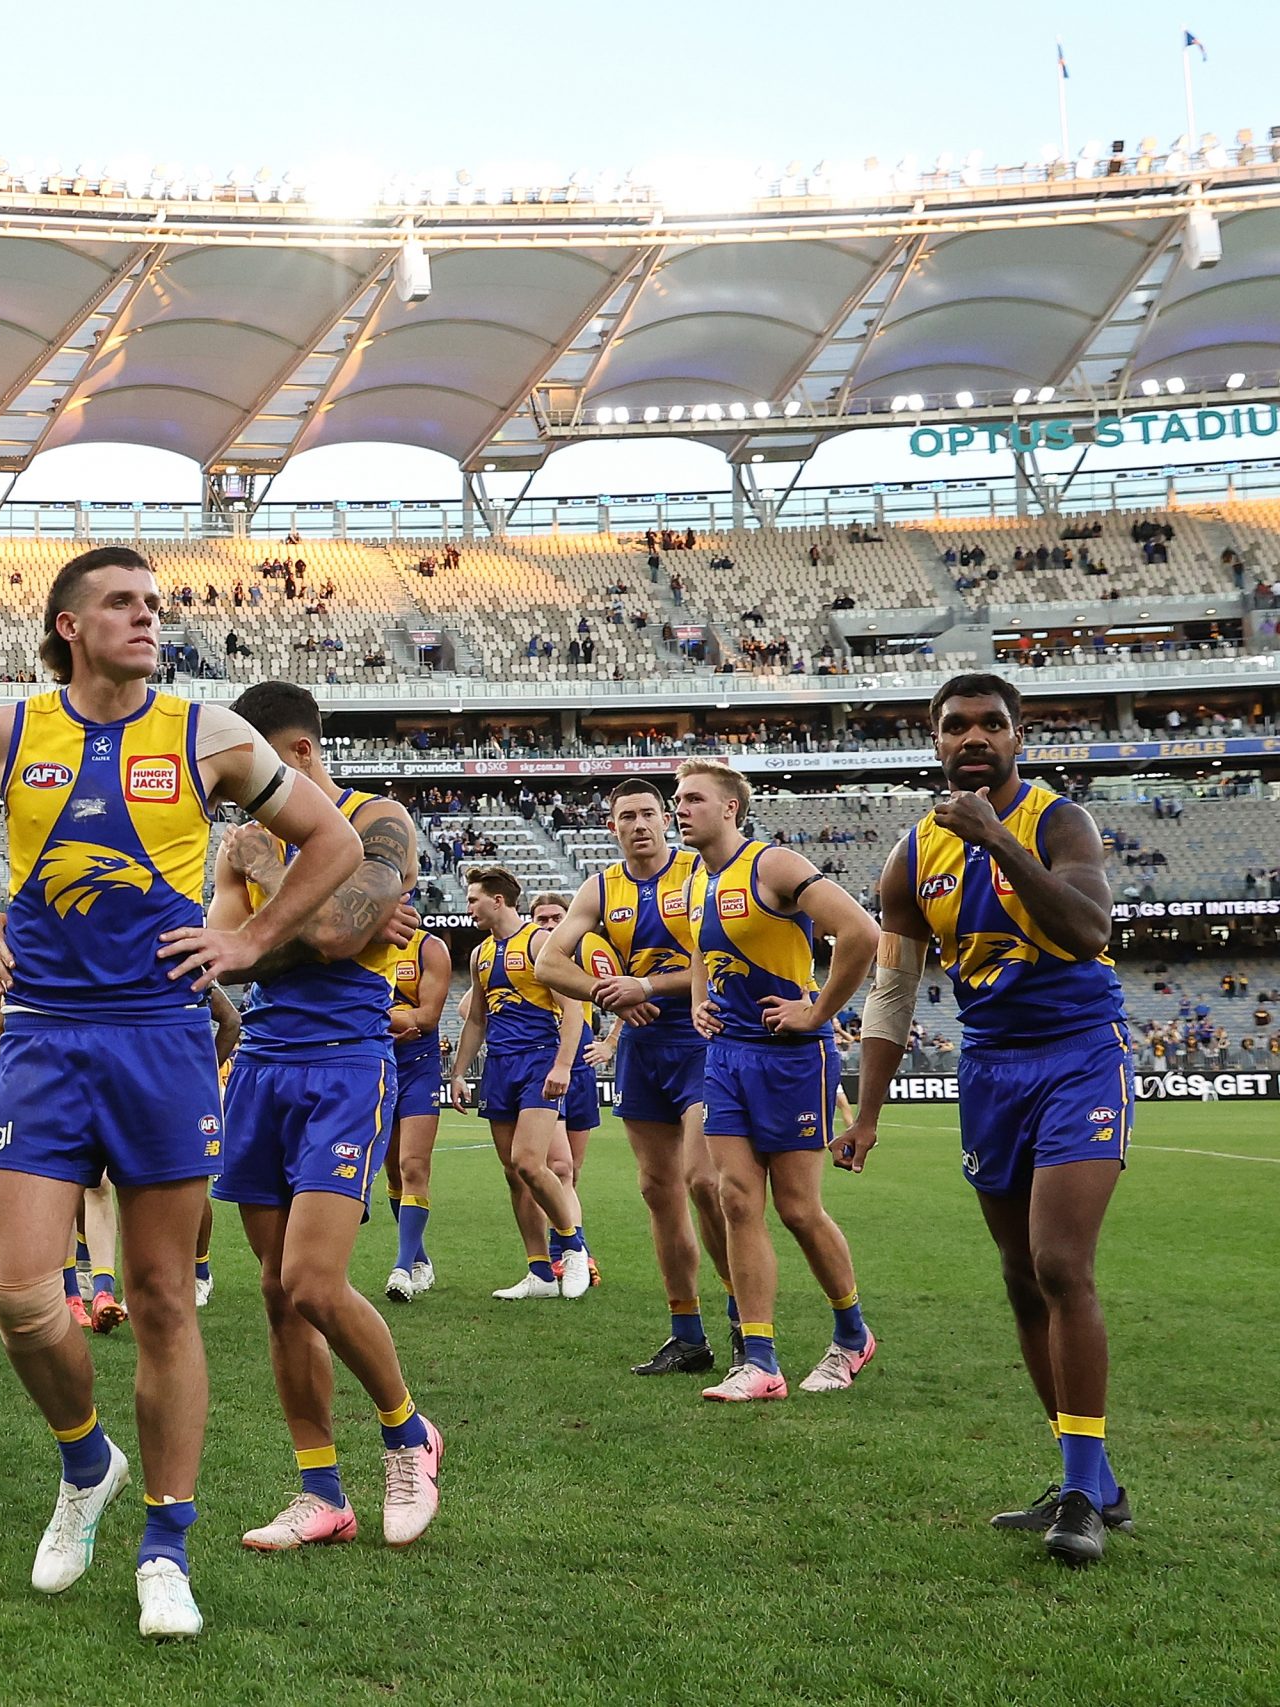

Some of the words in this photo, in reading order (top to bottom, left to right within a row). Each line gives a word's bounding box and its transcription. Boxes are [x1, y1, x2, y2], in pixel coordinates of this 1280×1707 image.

[909, 420, 1076, 457] OPTUS
[1095, 407, 1280, 447] STADIU
[1026, 748, 1090, 760] EAGLES
[1160, 742, 1226, 755] EAGLES
[487, 762, 508, 771] SKG
[591, 761, 612, 770] SKG
[624, 761, 671, 770] skg.com.au
[832, 757, 903, 765] WORLD-CLASS
[340, 763, 401, 775] grounded.
[404, 762, 463, 774] grounded.
[519, 763, 566, 772] skg.com.au
[26, 768, 69, 783] AFL
[133, 770, 174, 778] HUNGRY
[132, 778, 174, 790] JACK'S
[922, 878, 954, 897] AFL
[611, 909, 631, 920] AFL
[1111, 901, 1166, 917] HINGS
[1168, 902, 1204, 916] GET
[423, 915, 476, 928] CROW
[1135, 1072, 1207, 1099] INGS
[1213, 1074, 1272, 1096] GET
[798, 1112, 817, 1122] AFL
[1089, 1110, 1116, 1121] AFL
[202, 1118, 219, 1131] AFL
[335, 1143, 361, 1159] AFL
[961, 1149, 980, 1176] agl
